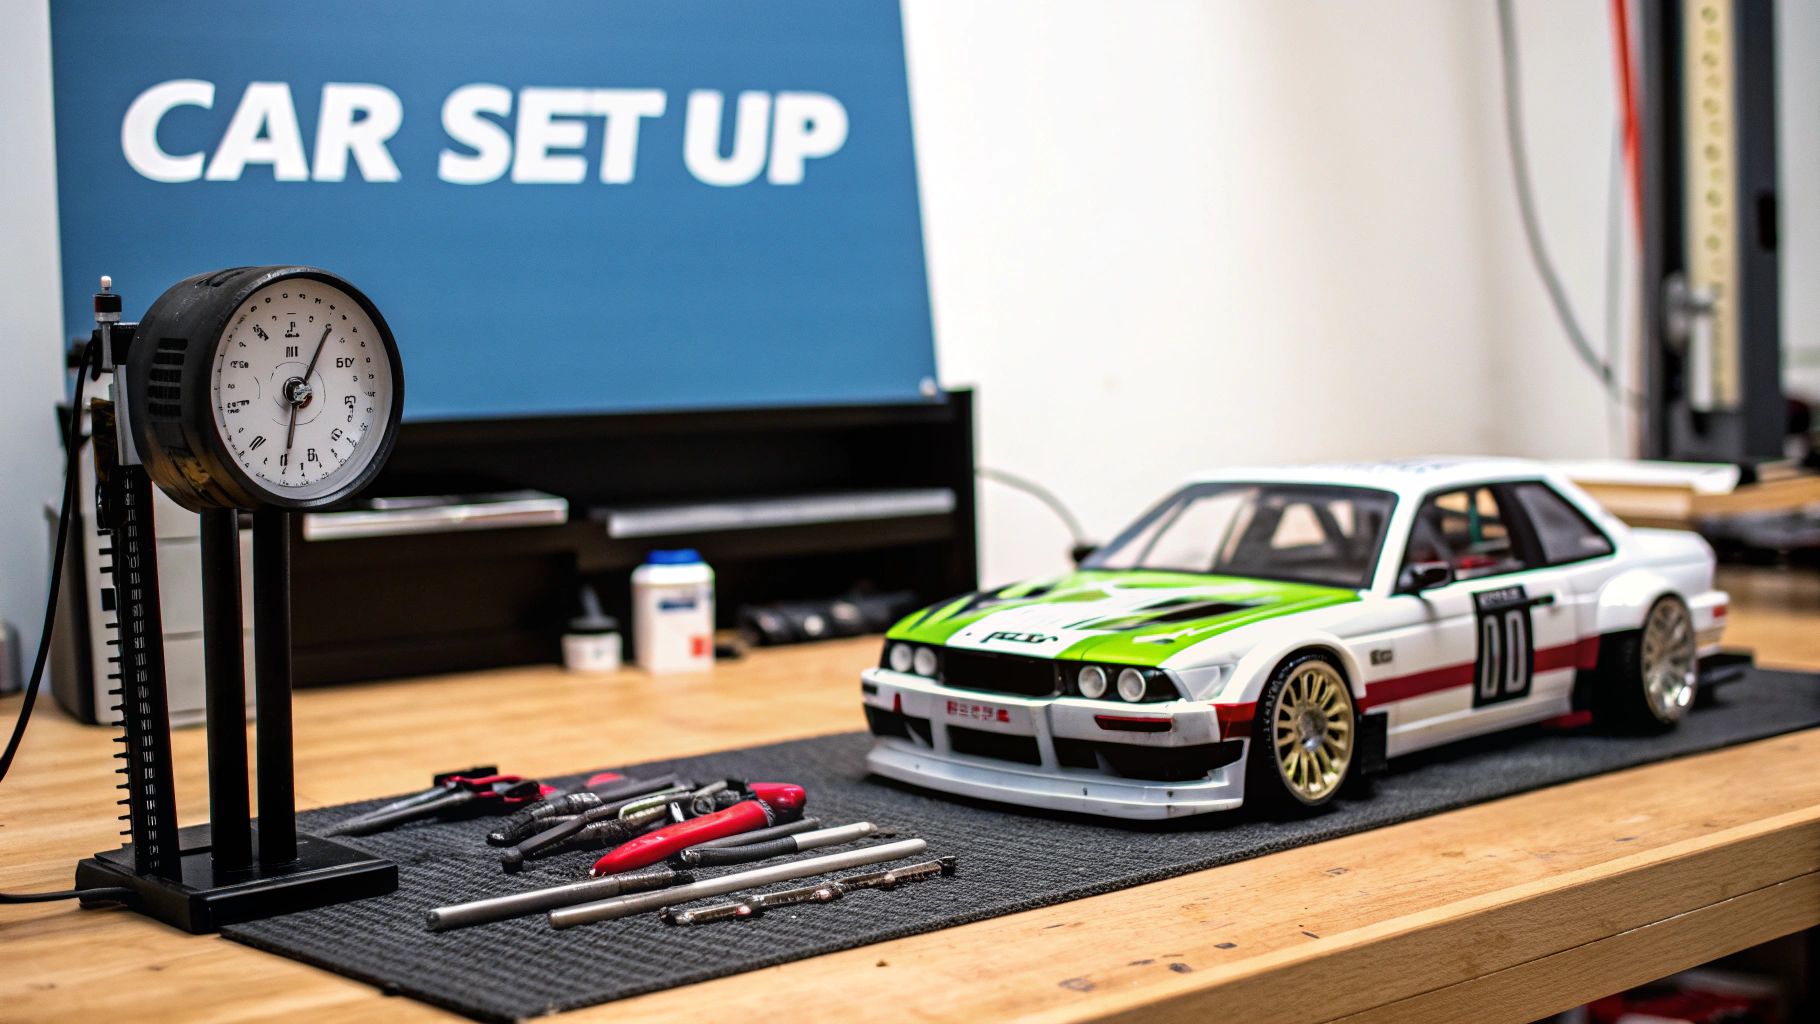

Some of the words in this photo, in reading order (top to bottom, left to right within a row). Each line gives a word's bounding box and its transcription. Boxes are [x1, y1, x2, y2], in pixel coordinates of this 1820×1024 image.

[121, 80, 403, 184] CAR
[438, 84, 667, 185] SET
[684, 90, 849, 187] UP
